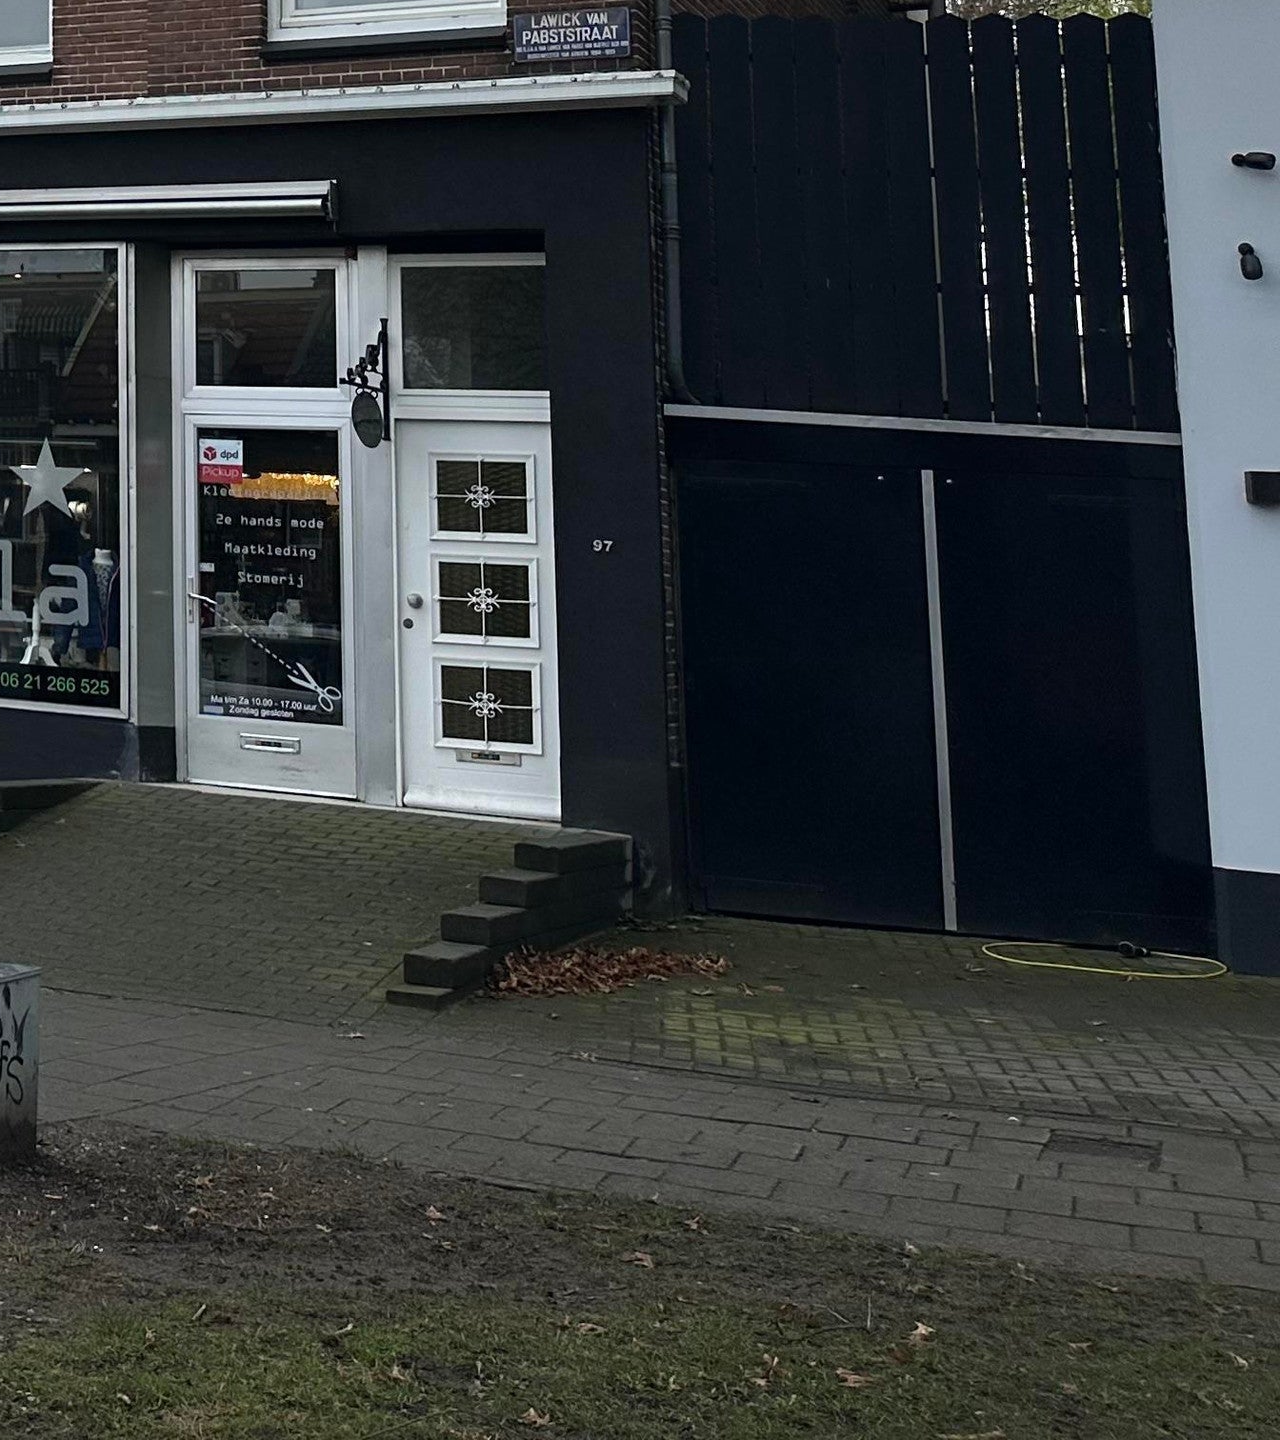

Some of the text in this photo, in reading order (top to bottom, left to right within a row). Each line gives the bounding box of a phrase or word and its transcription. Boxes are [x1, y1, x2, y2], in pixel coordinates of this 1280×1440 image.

[531, 12, 608, 29] LAWICK VAN
[522, 25, 619, 45] PABSTSTRAAT
[220, 449, 239, 461] dpd
[202, 466, 240, 478] Pickup
[216, 513, 325, 529] 2e hands mode
[224, 542, 317, 560] Maatkleding
[592, 539, 614, 553] 97
[237, 571, 304, 589] Stomerij
[0, 672, 20, 687] 06
[23, 674, 41, 690] 21
[47, 676, 77, 692] 266
[80, 679, 111, 695] 525
[238, 696, 250, 705] Za
